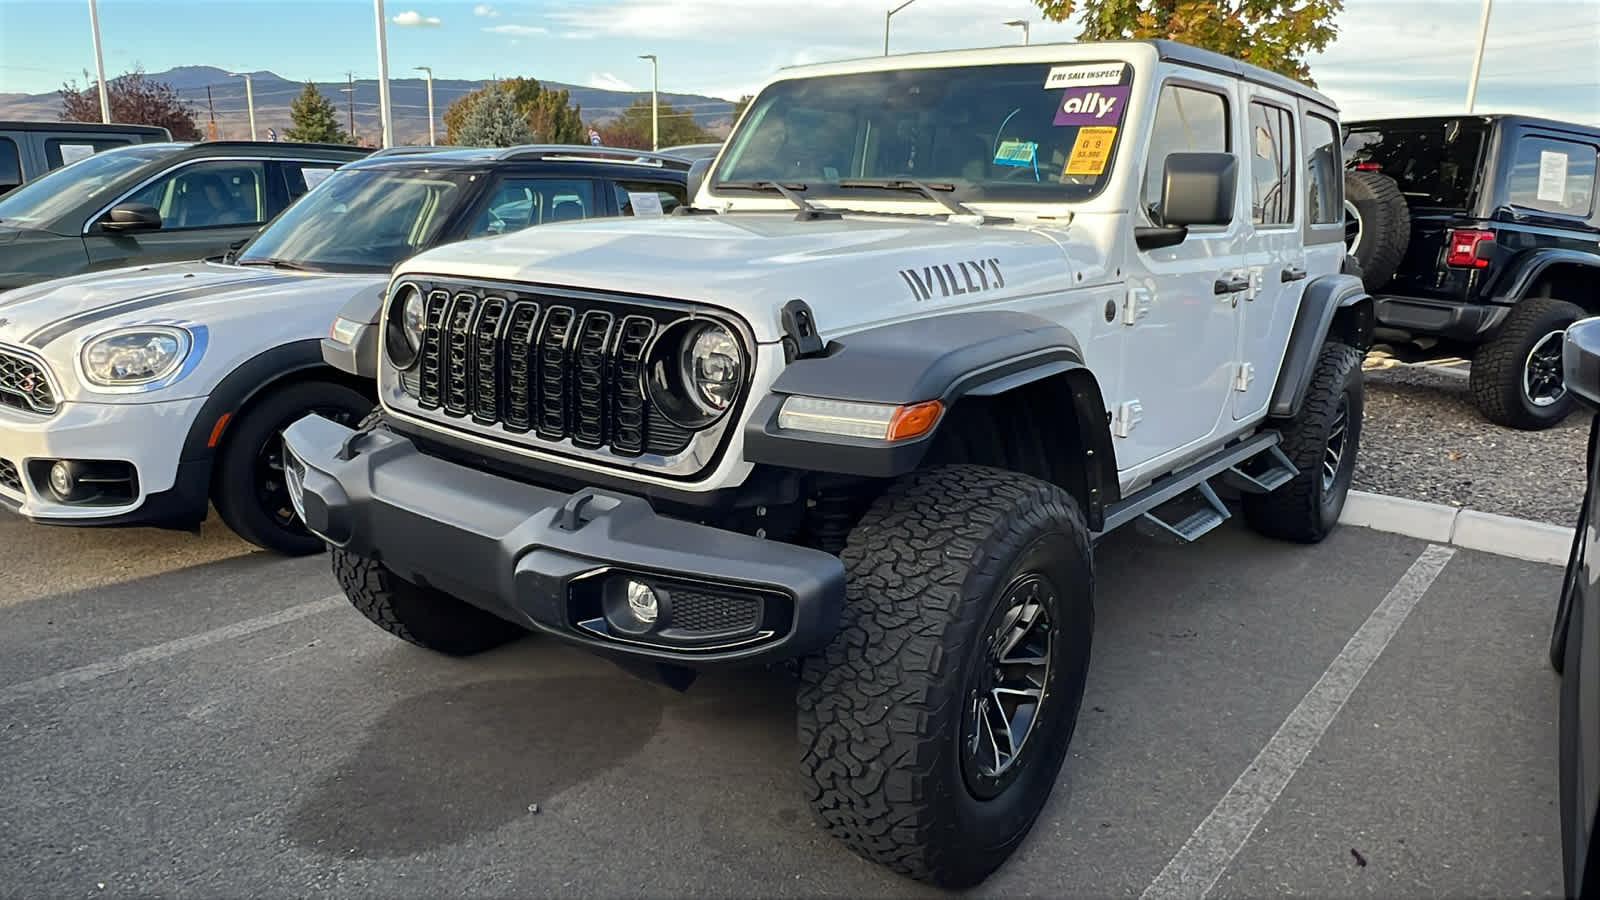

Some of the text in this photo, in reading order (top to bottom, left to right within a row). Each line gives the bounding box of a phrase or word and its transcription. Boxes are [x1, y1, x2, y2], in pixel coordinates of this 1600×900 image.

[1067, 71, 1086, 80] SALE
[1087, 70, 1122, 79] INSPECT
[898, 257, 1005, 301] WILLYS
